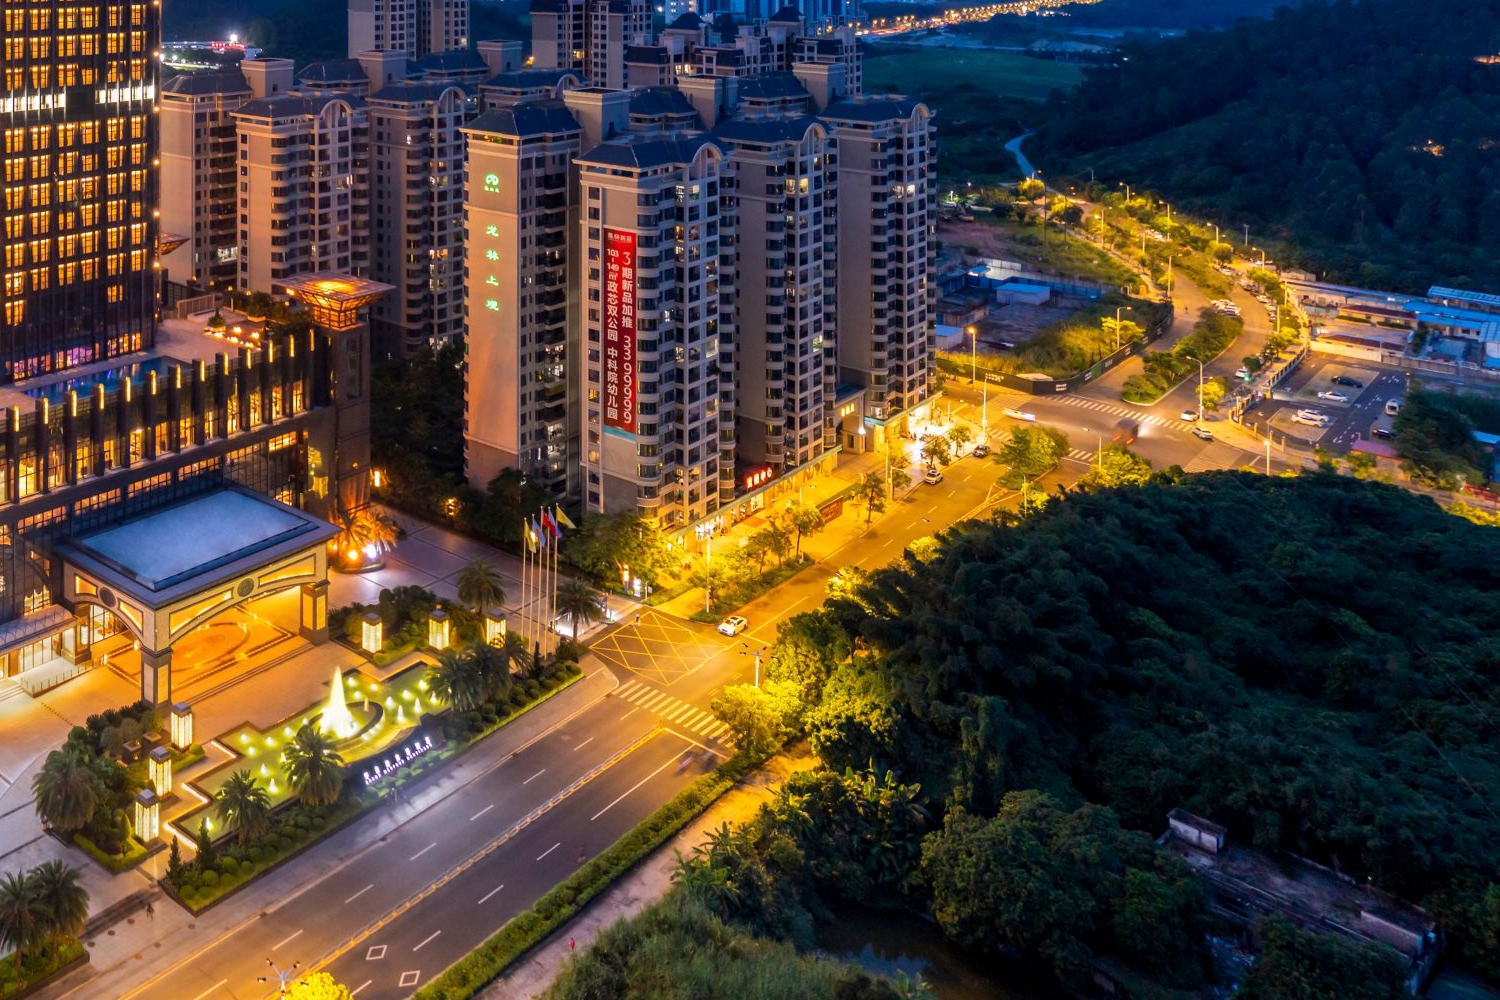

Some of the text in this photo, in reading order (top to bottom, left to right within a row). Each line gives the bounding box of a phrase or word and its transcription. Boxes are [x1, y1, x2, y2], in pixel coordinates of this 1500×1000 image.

[607, 346, 619, 421] 中科院幼儿园
[621, 251, 633, 424] 3期新品加推 3399999
